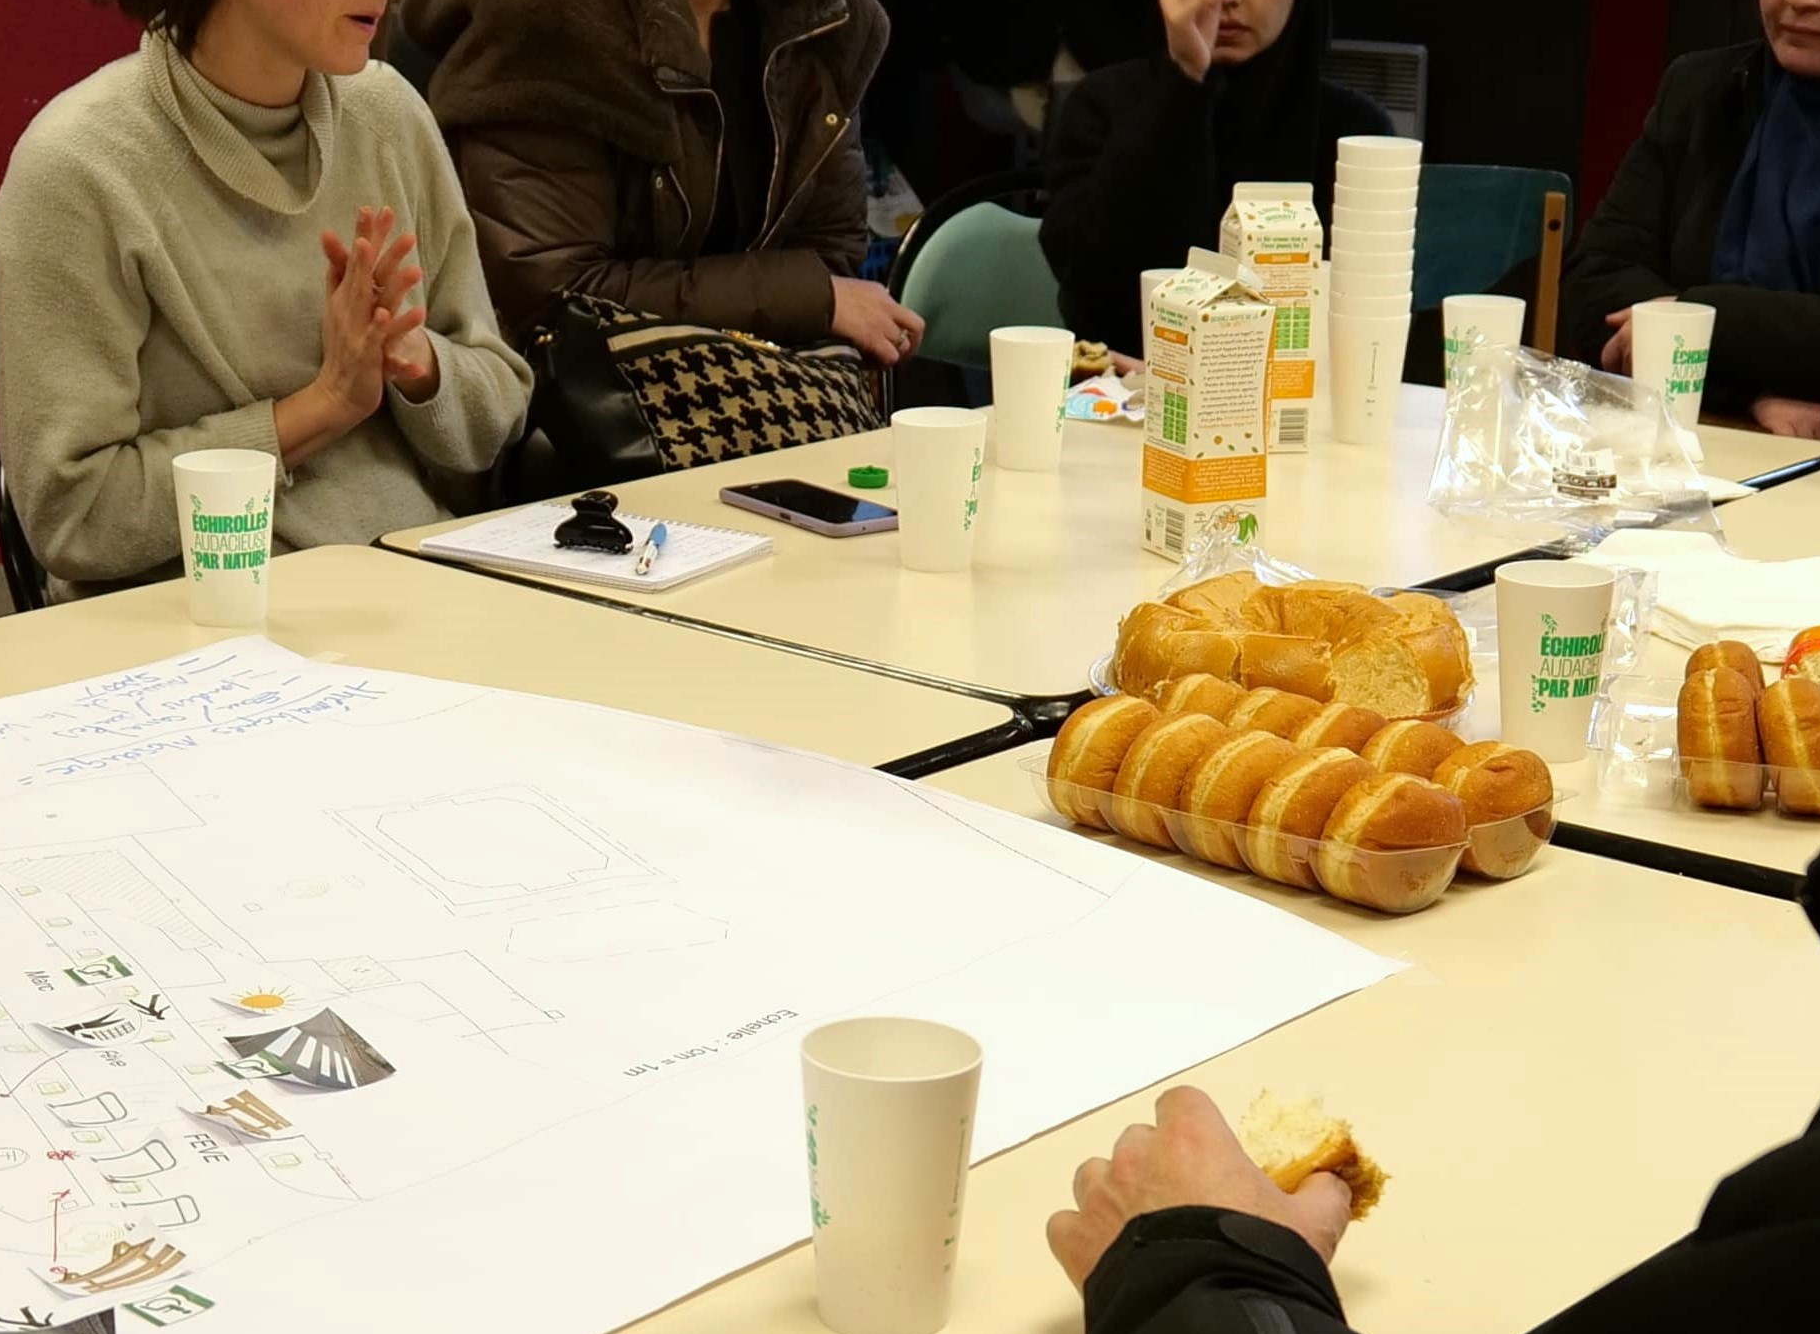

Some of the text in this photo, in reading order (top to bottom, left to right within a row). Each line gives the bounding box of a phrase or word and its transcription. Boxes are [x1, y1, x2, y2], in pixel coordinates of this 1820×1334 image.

[191, 509, 269, 534] ÉCHIROLLES
[195, 548, 267, 570] PAR NATURE
[1539, 630, 1607, 657] ÉCHIROL
[1539, 655, 1601, 678] AUDACIE
[1537, 675, 1601, 698] PAR NAT
[24, 970, 55, 994] Marc
[726, 1009, 800, 1041] Echelle
[673, 1044, 719, 1060] 1cm
[622, 1062, 660, 1078] 1m
[183, 1132, 231, 1166] FEVE
